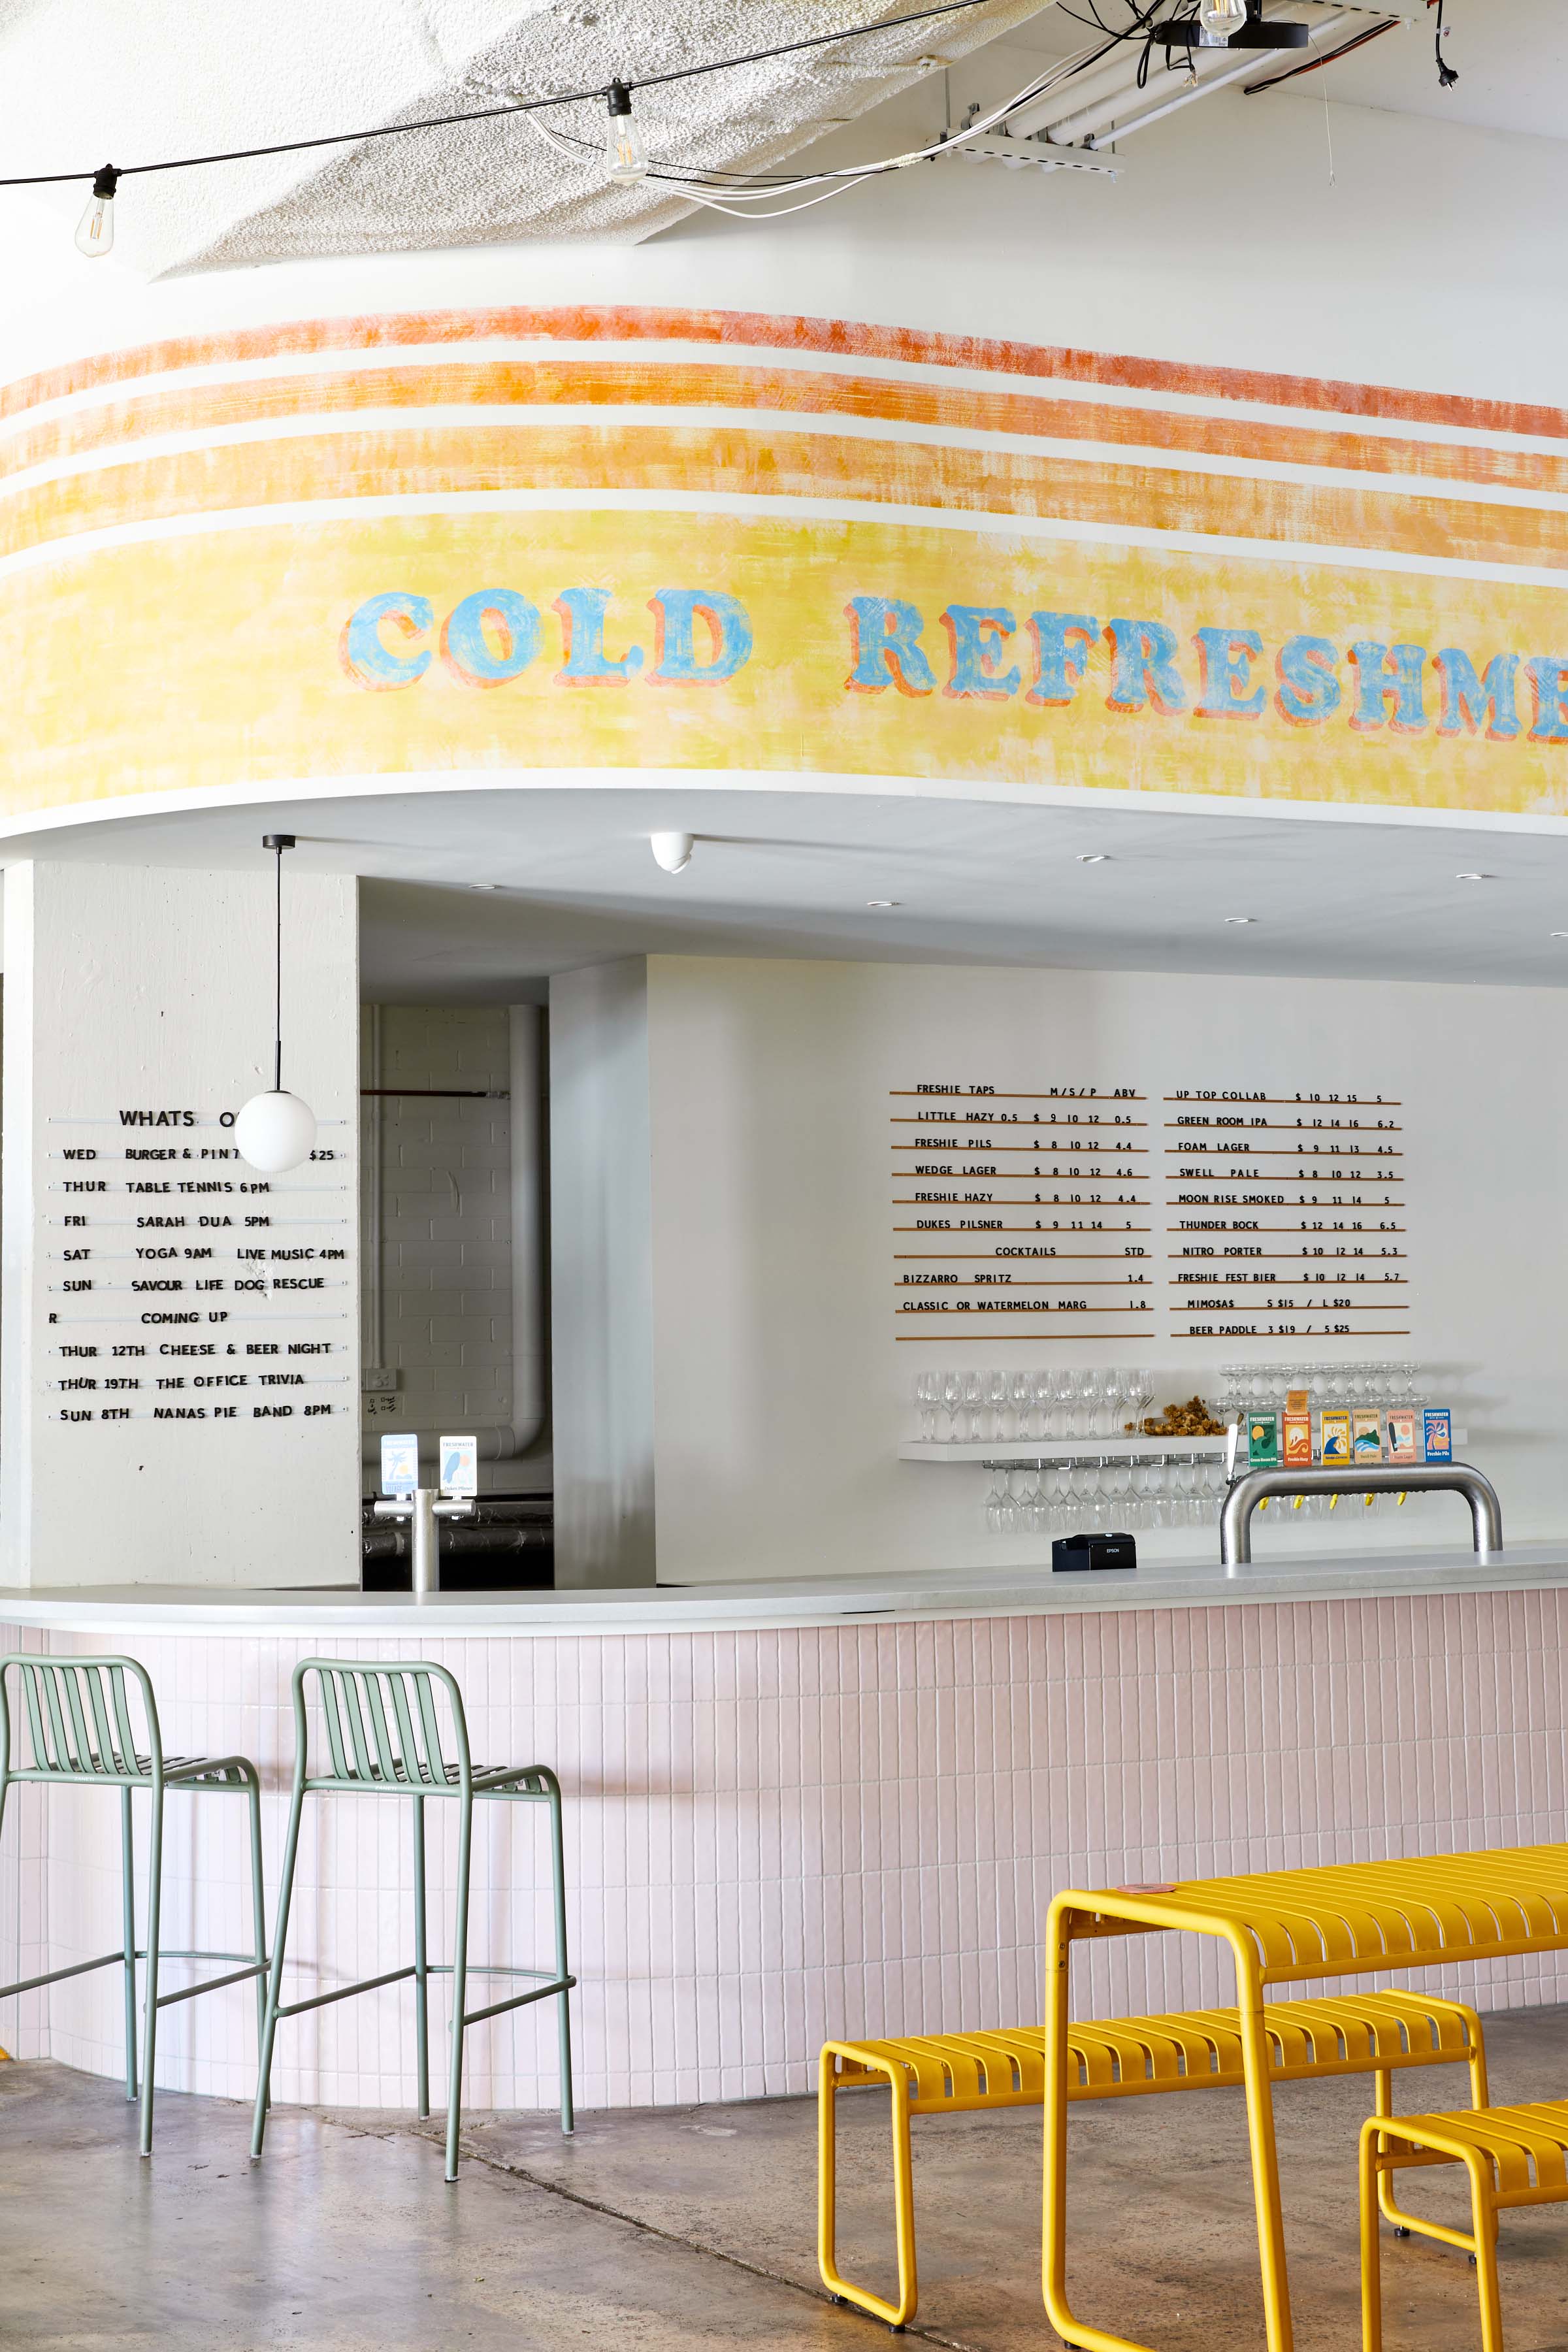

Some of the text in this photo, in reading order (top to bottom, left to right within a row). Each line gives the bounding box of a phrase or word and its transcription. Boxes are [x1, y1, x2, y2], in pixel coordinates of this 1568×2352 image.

[338, 589, 753, 691] COLD
[917, 1084, 1135, 1098] FRESHIE TAPS ABV
[1176, 1090, 1357, 1103] UP TOP COLLAB 10 12 15
[119, 1110, 240, 1128] WHATS O
[918, 1111, 956, 1120] LITTLE
[966, 1112, 994, 1122] HAZY
[1068, 1114, 1078, 1123] 10
[1088, 1115, 1099, 1124] 12
[1177, 1116, 1209, 1125] GREEN
[1217, 1117, 1243, 1126] ROOM
[1251, 1117, 1267, 1126] IPA
[1313, 1119, 1322, 1127] 12
[1331, 1119, 1340, 1128] 14
[1349, 1119, 1359, 1128] 16
[915, 1138, 958, 1148] FRESHIE
[968, 1139, 992, 1149] PILS
[1088, 1141, 1099, 1150] 12
[1178, 1142, 1207, 1151] FOAM
[1217, 1143, 1250, 1152] LAGER
[63, 1149, 96, 1160] WED
[125, 1149, 176, 1160] BURGER
[182, 1148, 191, 1159] &
[309, 1150, 334, 1162] $25
[915, 1166, 953, 1175] WEDGE
[963, 1166, 996, 1175] LAGER
[1090, 1168, 1101, 1176] 12
[1180, 1168, 1214, 1177] SWELL
[1231, 1169, 1259, 1178] PALE
[1350, 1170, 1361, 1179] 12
[62, 1181, 106, 1192] THUR
[125, 1182, 171, 1193] TABLE
[177, 1181, 233, 1193] TENNIS
[915, 1192, 958, 1201] FRESHIE
[964, 1193, 992, 1202] HAZY
[1090, 1194, 1101, 1203] 12
[1179, 1194, 1284, 1204] MOON RISE SMOKED
[64, 1215, 270, 1228] FRI SARAH DUA 5PM
[917, 1220, 951, 1229] DUKES
[960, 1220, 1003, 1229] PILSNER
[1179, 1220, 1226, 1229] THUNDER
[1233, 1220, 1258, 1230] BOCK
[1333, 1222, 1344, 1230] 14
[1352, 1222, 1362, 1230] 16
[63, 1247, 344, 1261] SAT YOGA 9AM LIVE MUSIC 4PM
[995, 1247, 1144, 1256] COCKTAILS STD
[1183, 1247, 1214, 1256] NITRO
[1224, 1247, 1262, 1256] PORTER
[1337, 1247, 1345, 1256] 12
[1354, 1247, 1364, 1256] 14
[904, 1274, 958, 1283] BIZZARRO
[974, 1274, 1011, 1283] SPRITZ
[1178, 1273, 1218, 1282] FRESHIE
[1226, 1273, 1249, 1282] FEST
[1253, 1273, 1276, 1282] BIER
[1337, 1273, 1346, 1281] 12
[1356, 1273, 1365, 1281] 14
[63, 1277, 325, 1292] SUN SAVOUR LIFE DOG RESCUE
[903, 1301, 949, 1311] CLASSIC
[956, 1301, 970, 1310] OR
[977, 1301, 1049, 1310] WATERMELON
[1058, 1301, 1086, 1309] MARG
[1278, 1299, 1294, 1307] $15
[1333, 1299, 1350, 1307] $20
[48, 1311, 228, 1324] R COMING UP
[1190, 1324, 1349, 1335] BEER PADDLE $19 $25
[58, 1343, 331, 1358] THUR 12TH CHEESE & BEER NIGHT
[57, 1374, 304, 1391] THUR 19TH THE OFFICE TRIVIA
[60, 1404, 331, 1422] SUN 8TH NANAS PIE BAND 8PM
